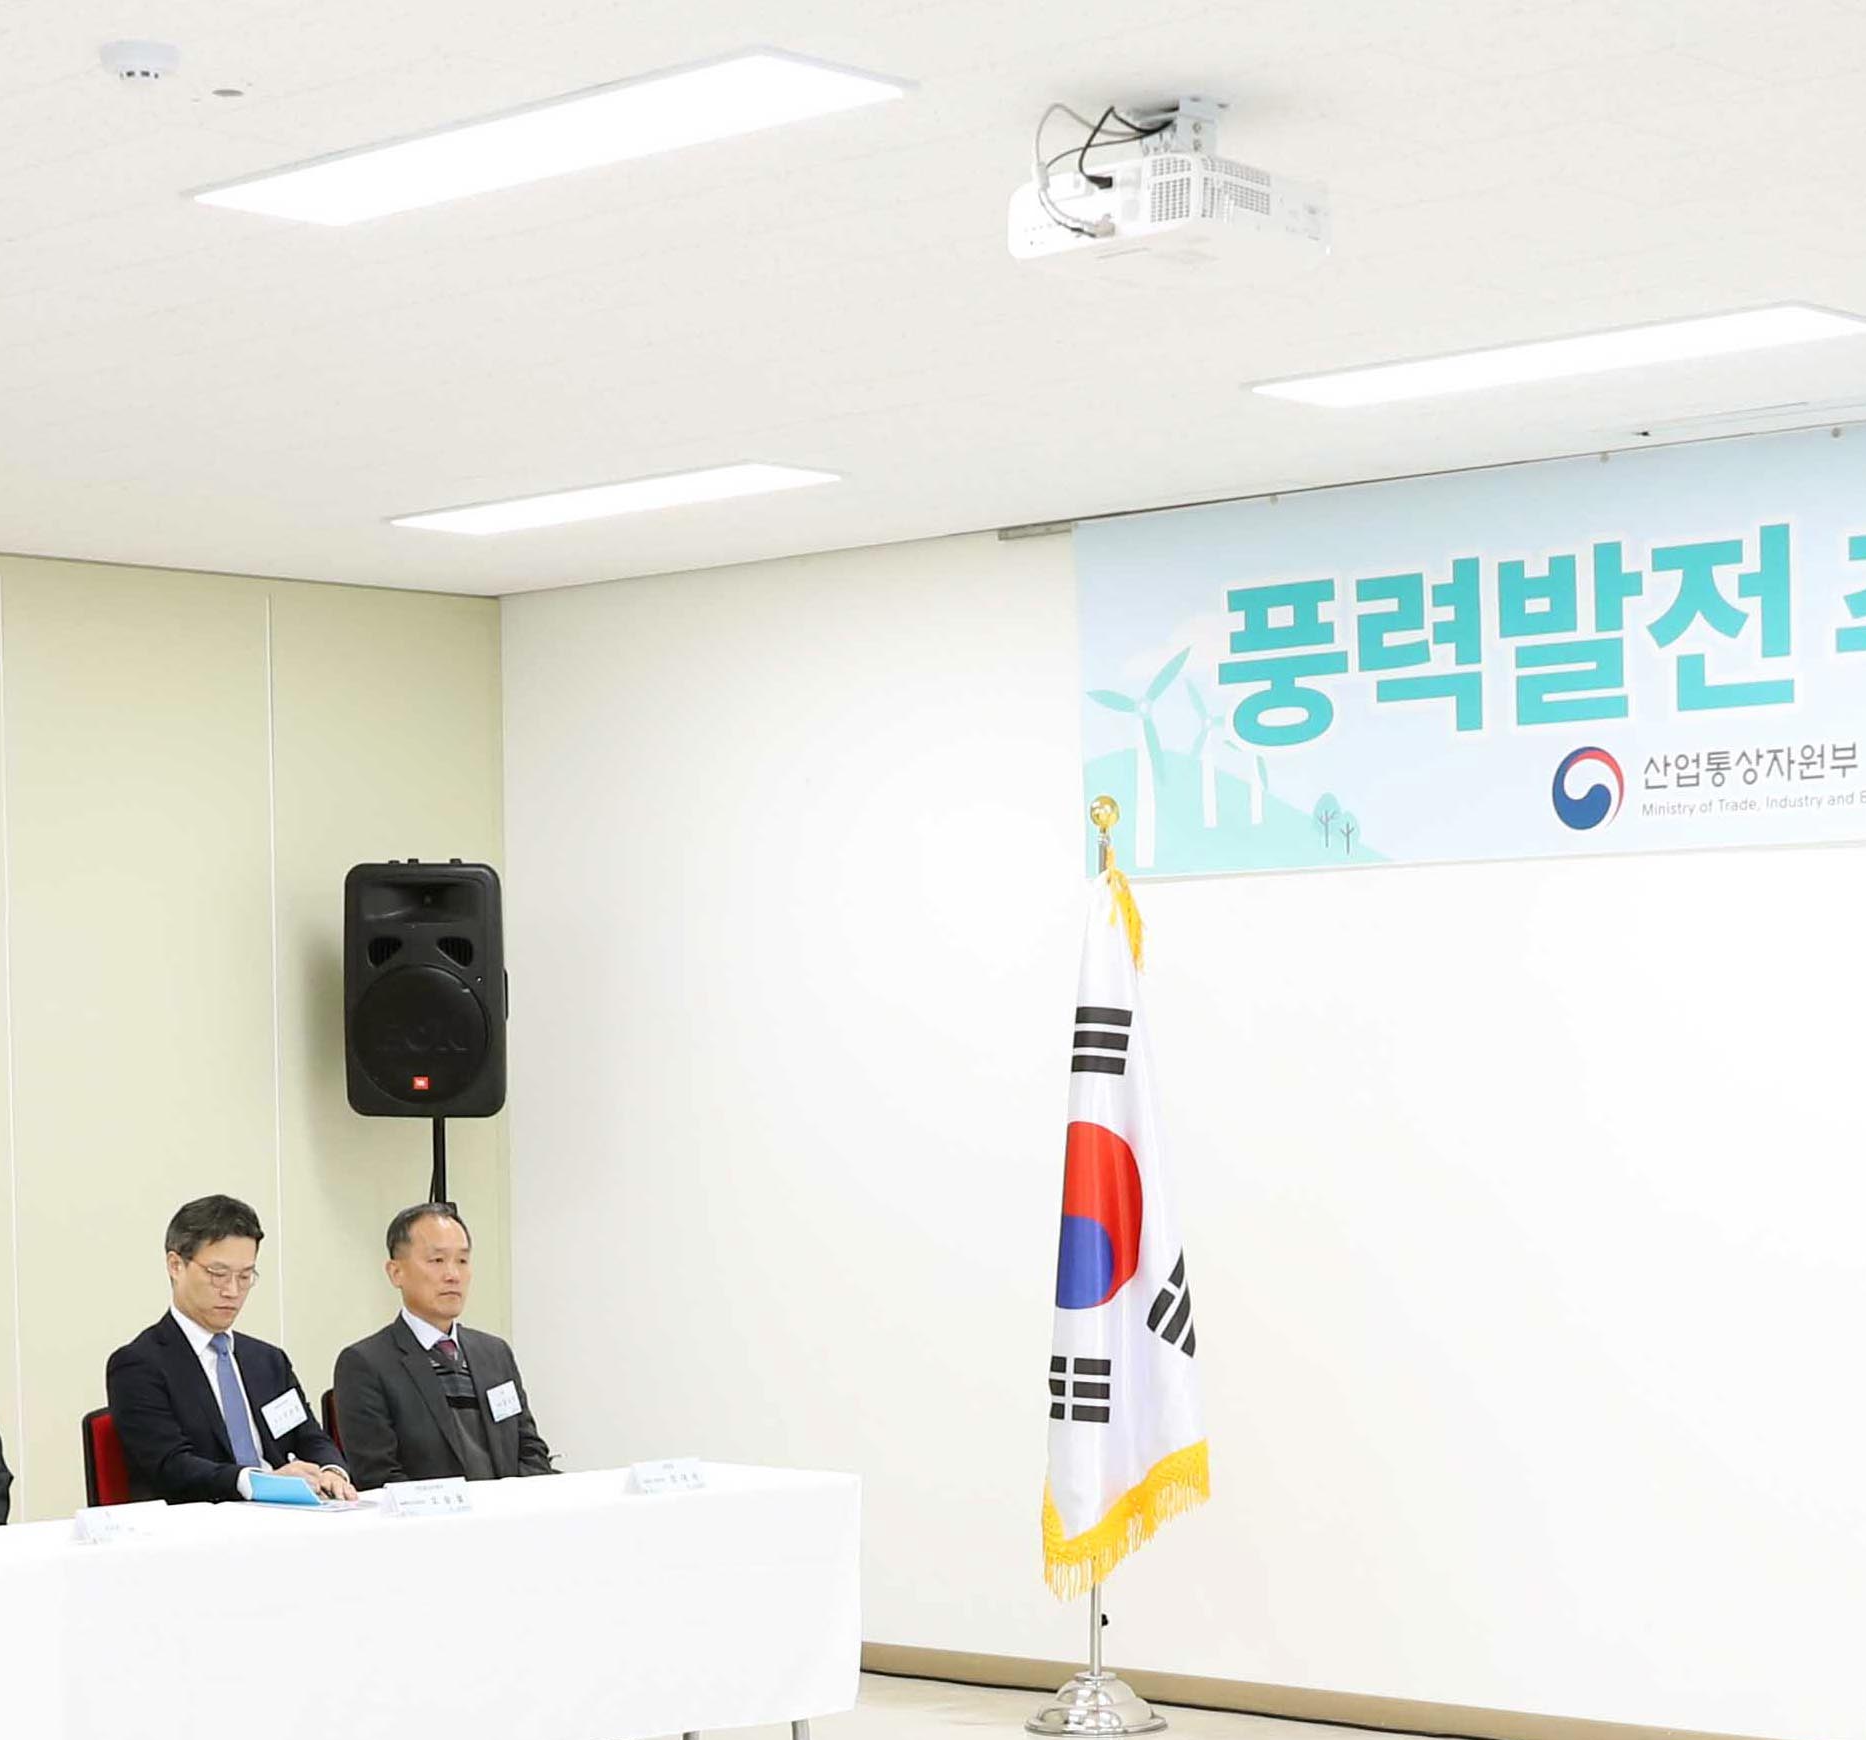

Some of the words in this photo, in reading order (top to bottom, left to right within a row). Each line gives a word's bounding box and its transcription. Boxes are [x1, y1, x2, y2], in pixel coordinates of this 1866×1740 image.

[1220, 524, 1792, 746] 풍력발전
[1643, 743, 1859, 790] 산업통상자원부
[1641, 801, 1697, 817] Ministry
[1700, 800, 1714, 813] of
[1718, 798, 1761, 813] Trade,
[1765, 794, 1823, 812] Industry
[1828, 792, 1855, 806] and
